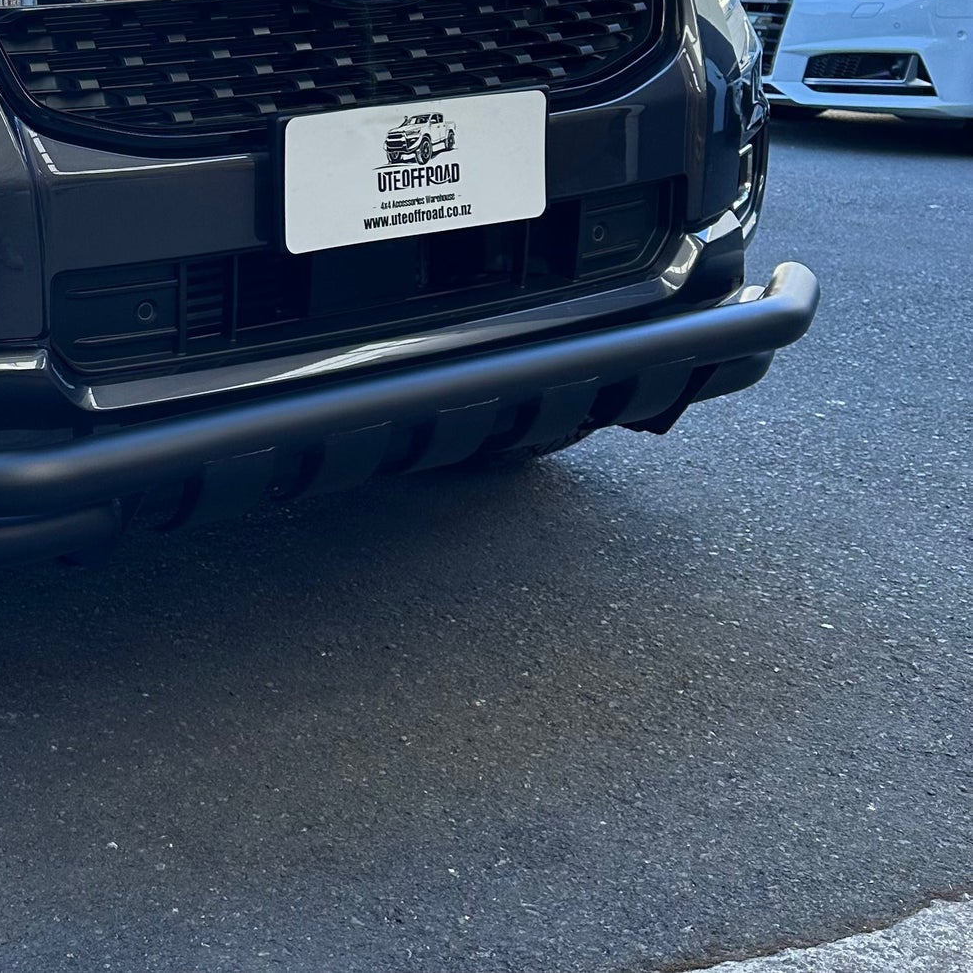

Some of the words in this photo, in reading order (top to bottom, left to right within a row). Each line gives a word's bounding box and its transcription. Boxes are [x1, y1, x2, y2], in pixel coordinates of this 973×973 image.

[377, 163, 460, 192] UTEOFFROAD
[380, 201, 391, 210] 4x4
[392, 196, 425, 208] Accessories
[425, 193, 455, 204] Warehouse
[363, 204, 472, 229] www.uteoffroad.co.nz
